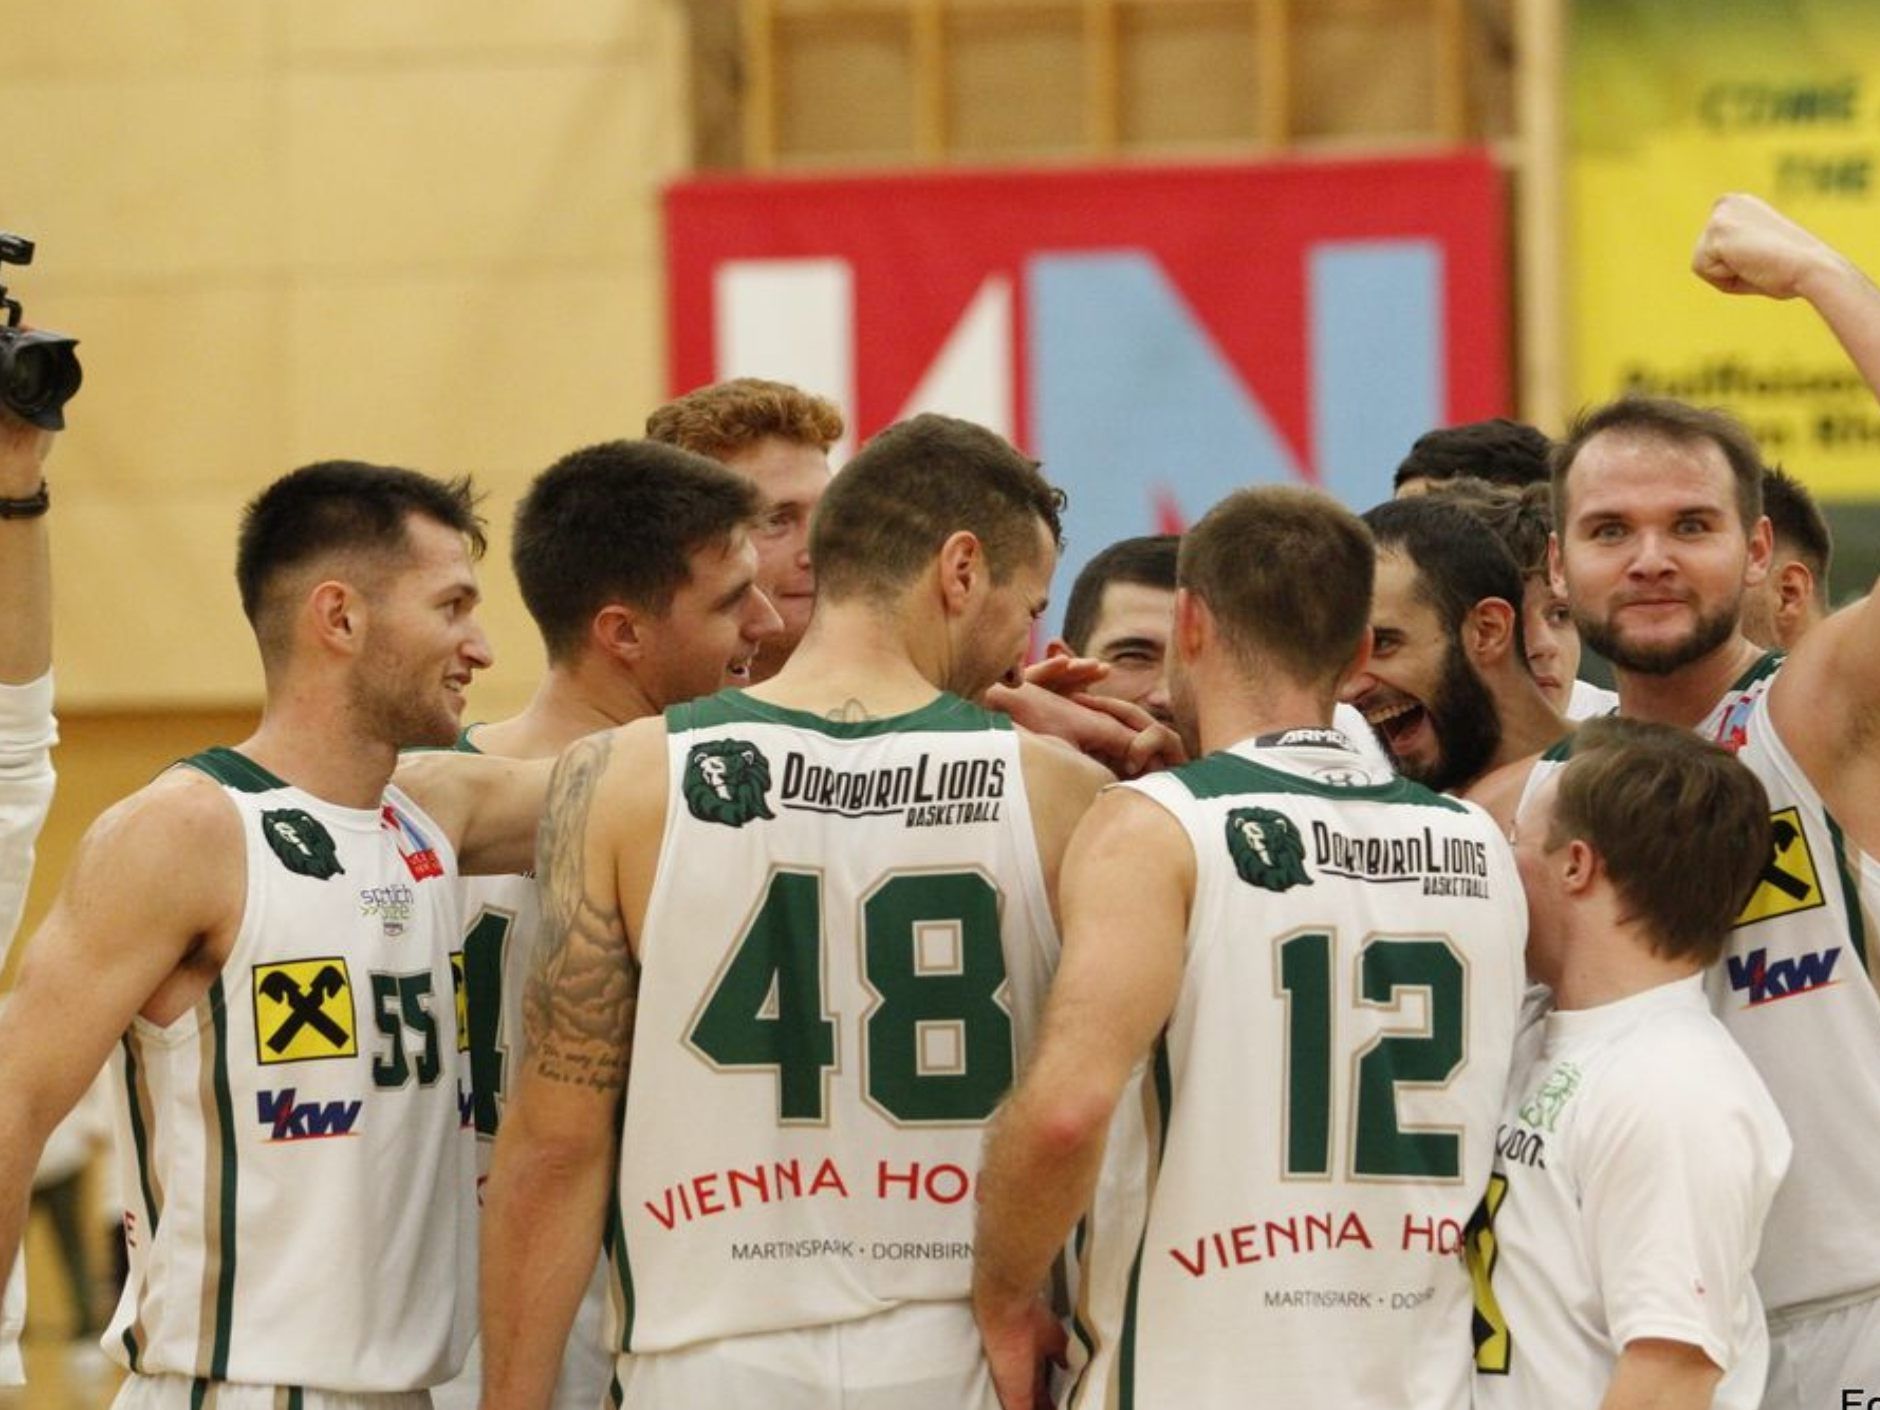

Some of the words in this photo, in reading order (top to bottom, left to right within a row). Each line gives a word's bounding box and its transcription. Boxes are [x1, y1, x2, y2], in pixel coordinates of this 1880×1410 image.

[906, 802, 1000, 827] BASKETBALL
[368, 970, 444, 1091] 55
[681, 863, 1019, 1129] 48
[1272, 926, 1470, 1185] 12
[644, 1157, 849, 1232] VIENNA
[877, 1160, 980, 1206] HO
[1169, 1210, 1373, 1278] VIENNA
[1401, 1212, 1465, 1256] HO
